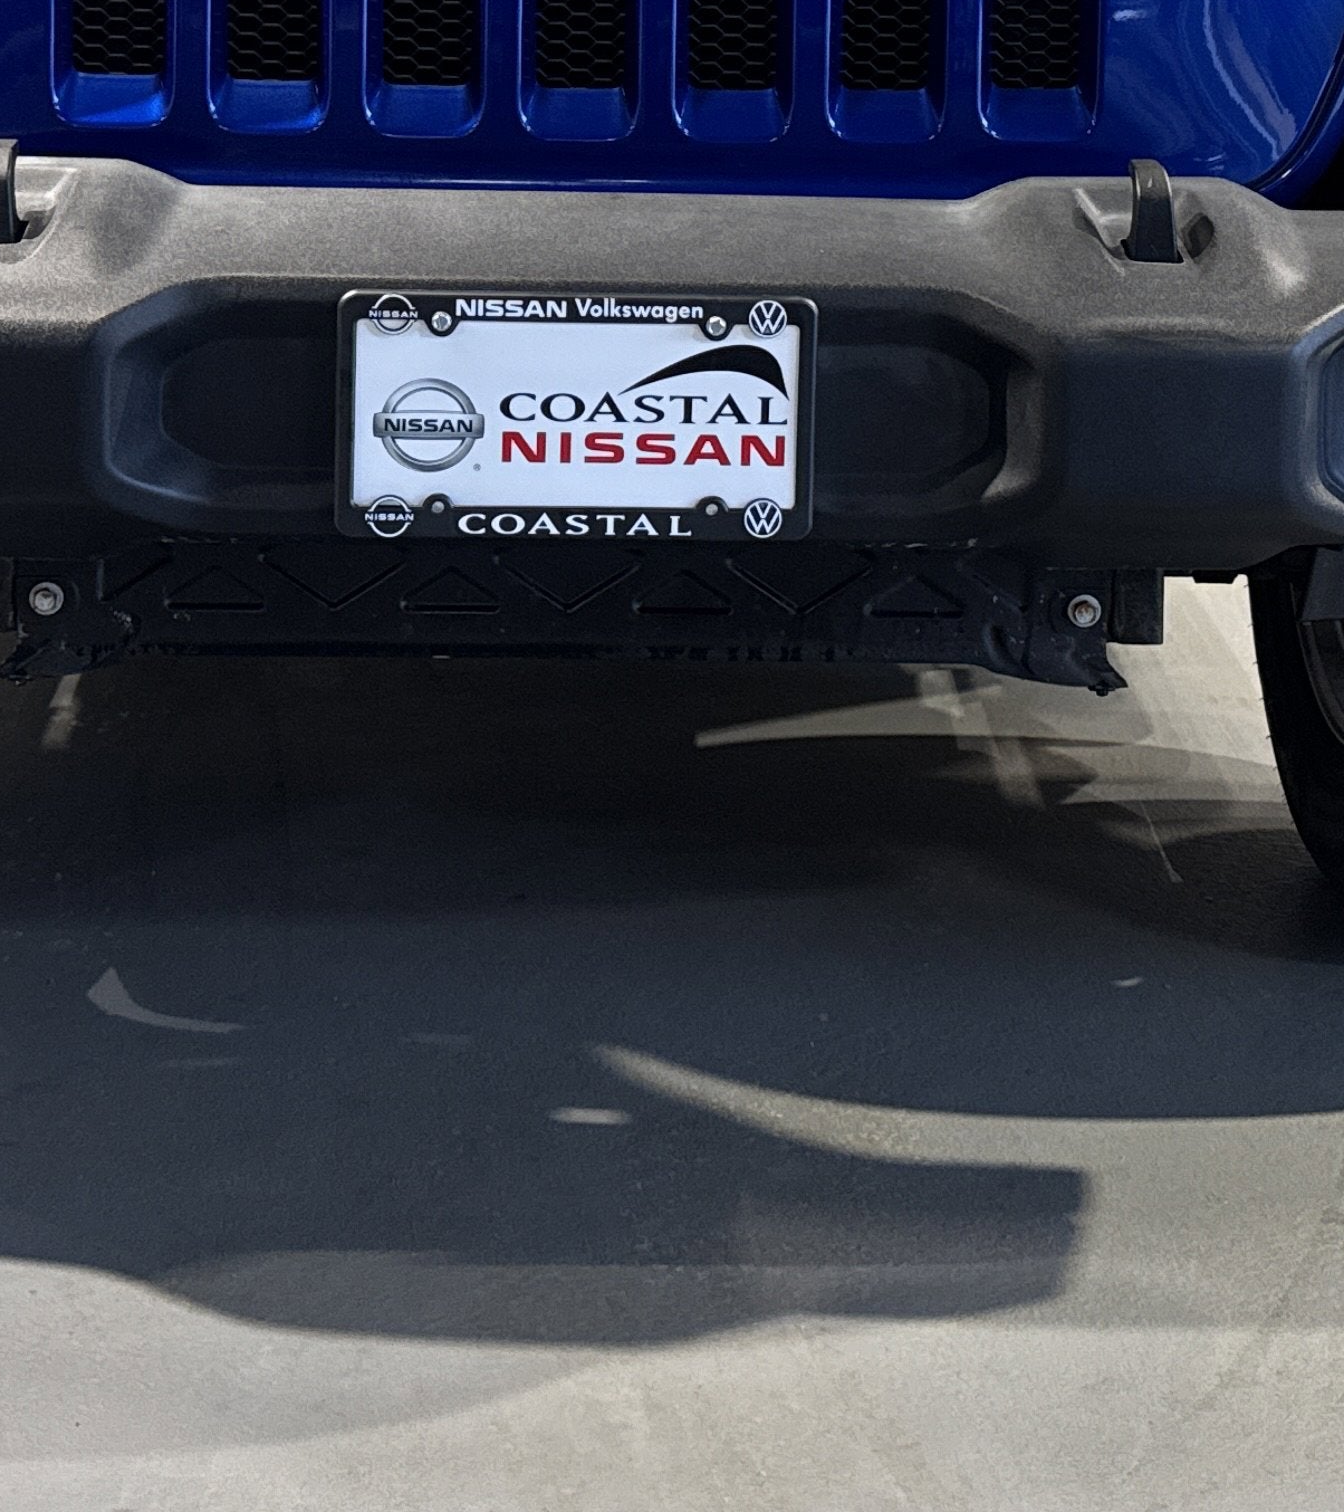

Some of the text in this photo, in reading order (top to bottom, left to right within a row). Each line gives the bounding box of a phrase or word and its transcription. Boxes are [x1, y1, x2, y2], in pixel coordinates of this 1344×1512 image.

[369, 310, 418, 318] NISSAN
[455, 298, 703, 323] NISSAN Volkswagen
[499, 392, 788, 425] COASTAL
[383, 418, 473, 433] NISSAN
[501, 431, 786, 467] NISSAN
[364, 513, 415, 521] NISSAN
[457, 513, 692, 536] COASTAL
